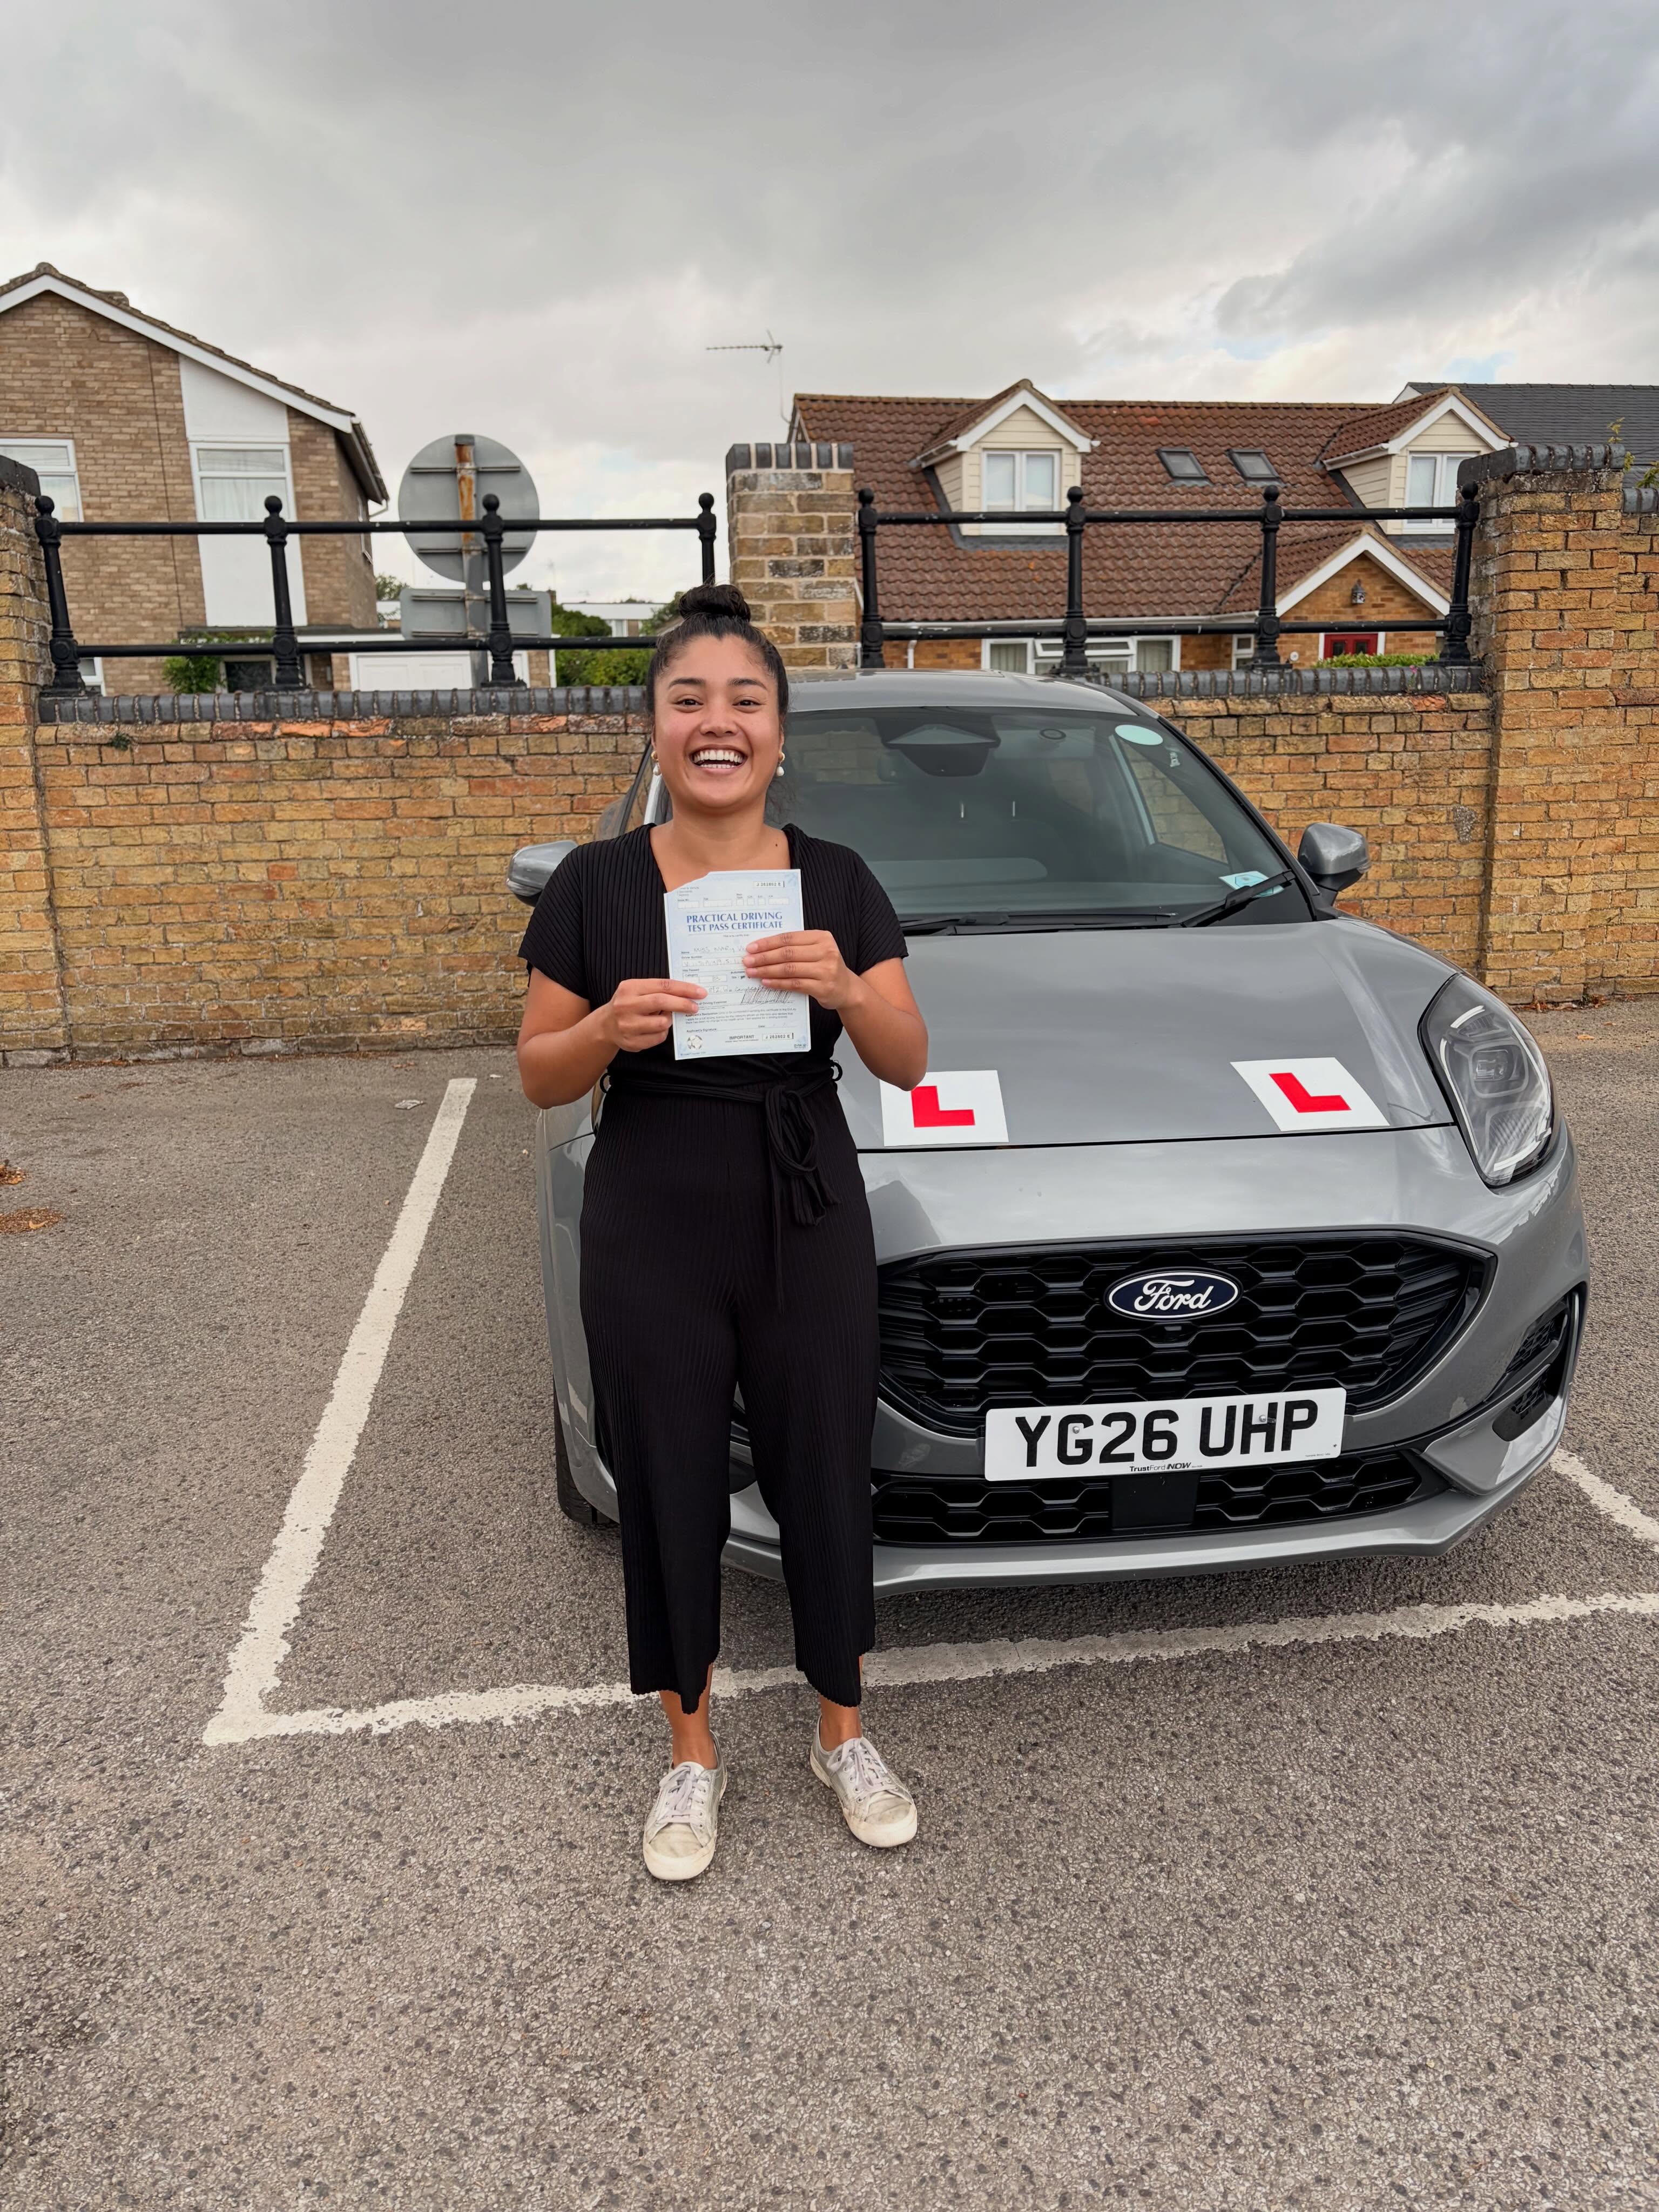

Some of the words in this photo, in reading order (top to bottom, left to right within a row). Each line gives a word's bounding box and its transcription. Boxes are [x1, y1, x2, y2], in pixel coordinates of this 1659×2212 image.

[686, 913, 738, 923] PRACTICAL
[741, 912, 783, 921] DRIVING
[687, 924, 706, 932] TEST
[709, 923, 729, 931] PASS
[731, 921, 783, 930] CERTIFICATE
[911, 1085, 975, 1128] L
[1269, 1073, 1352, 1114] L
[1134, 1279, 1214, 1311] Ford
[1015, 1409, 1179, 1468] YG26
[1199, 1399, 1318, 1457] UHP
[1166, 1462, 1192, 1470] NOW
